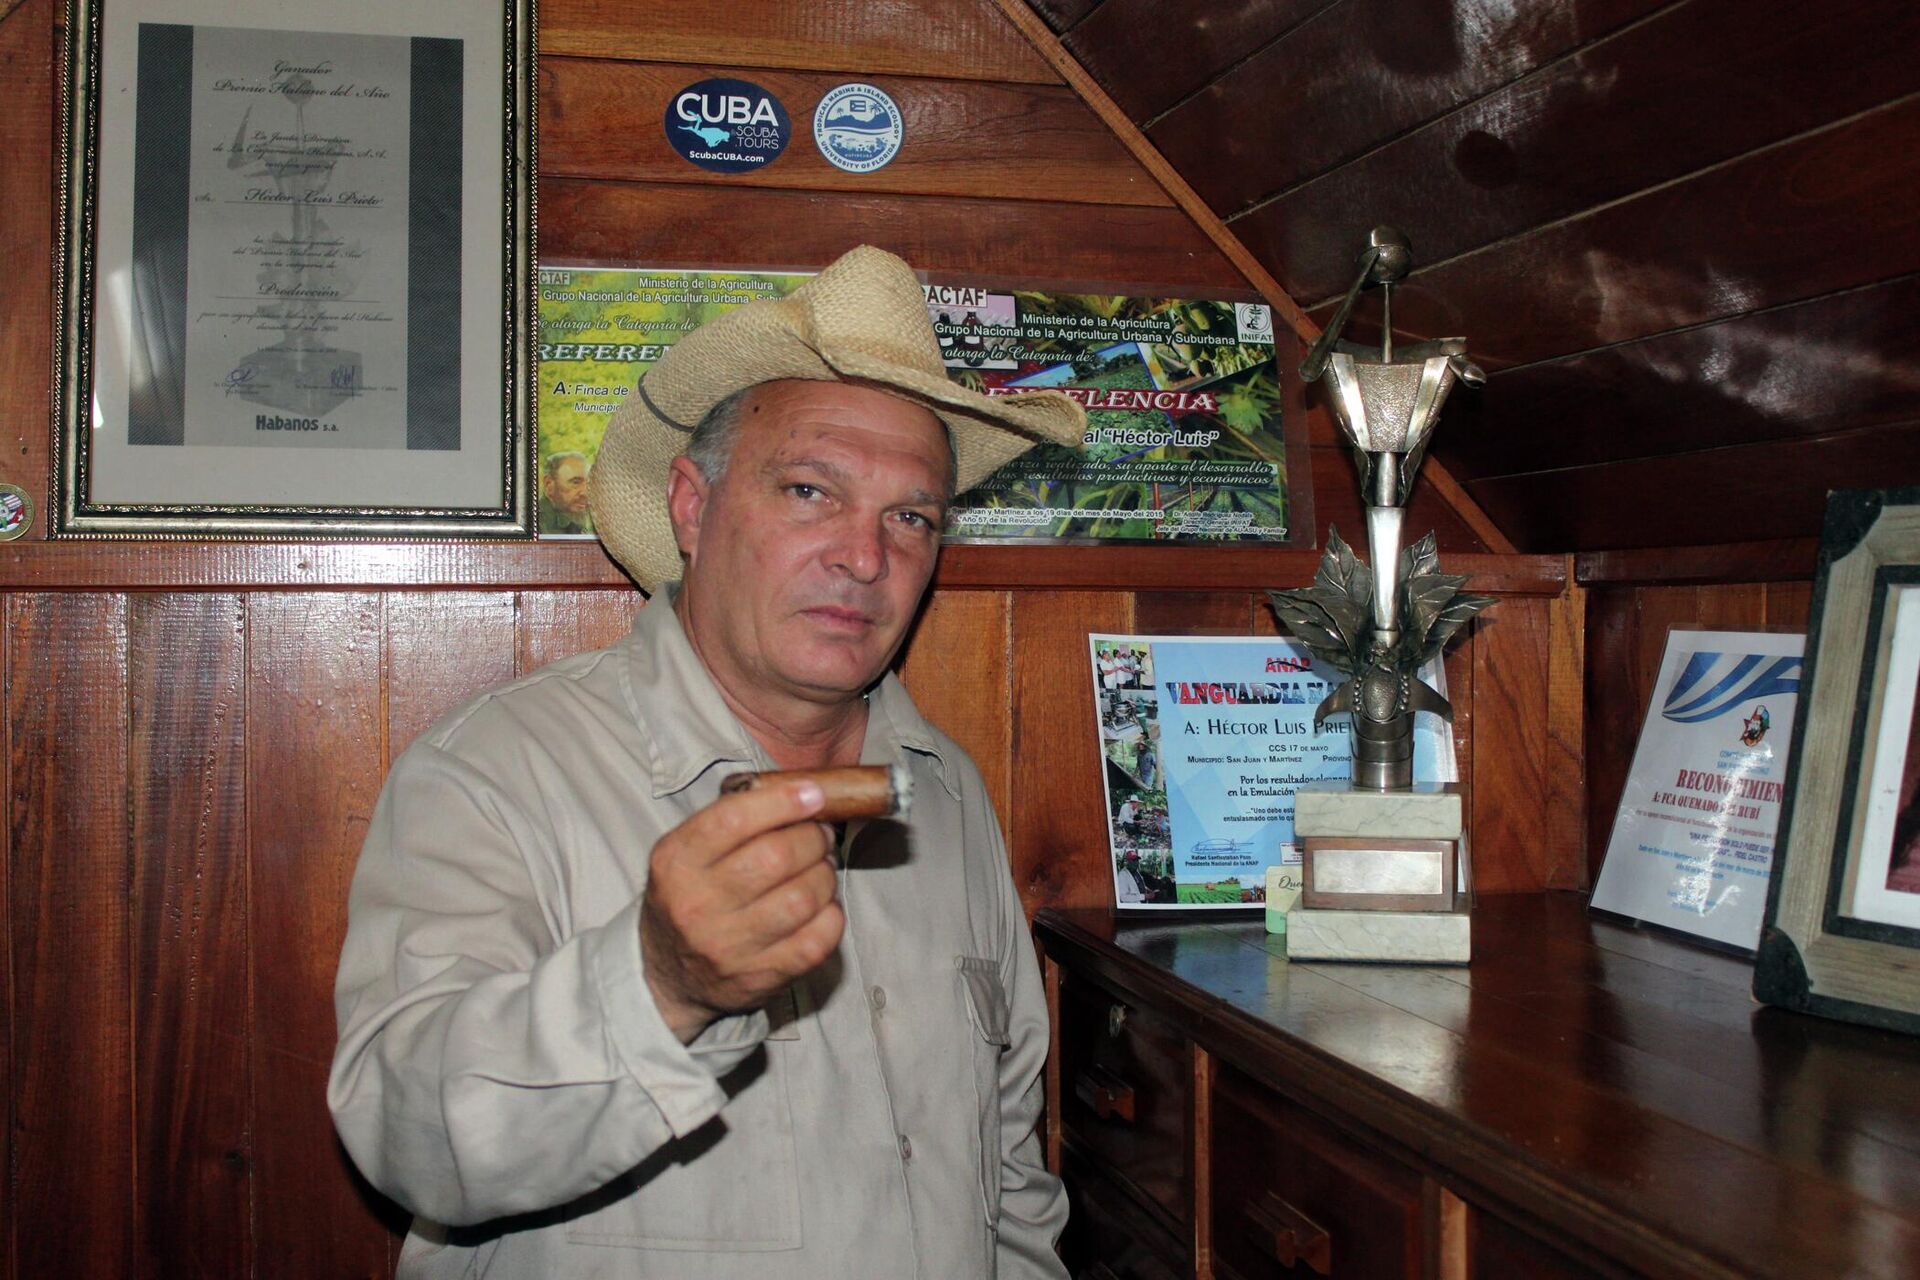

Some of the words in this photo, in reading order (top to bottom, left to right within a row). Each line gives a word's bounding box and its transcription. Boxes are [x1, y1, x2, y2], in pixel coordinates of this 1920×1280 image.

[270, 59, 334, 81] Ganador
[213, 79, 267, 94] Premio
[269, 79, 328, 98] Habano
[329, 84, 355, 98] del
[676, 92, 779, 127] CUBA
[816, 102, 831, 139] TROPICAL
[827, 86, 855, 103] MARINE
[864, 87, 889, 107] ISLAND
[886, 104, 900, 141] ECOLOGY
[735, 125, 779, 139] SCUBA
[736, 137, 779, 150] TOURS
[689, 150, 765, 163] ScubaCUBA.com
[821, 140, 860, 170] UNIVERSITY
[860, 162, 872, 170] OF
[871, 143, 897, 167] FLORIDA
[639, 277, 690, 289] Ministerio
[692, 279, 704, 289] de
[707, 279, 717, 290] la
[719, 279, 774, 293] Agricultura
[543, 290, 576, 304] Grupo
[578, 291, 624, 302] Nacional
[626, 292, 640, 303] de
[642, 292, 652, 303] la
[654, 292, 709, 305] Agricultura
[711, 293, 750, 304] Urbana
[927, 285, 985, 307] ACTAF
[551, 316, 593, 337] otorga
[594, 314, 612, 329] la
[1022, 313, 1077, 327] Ministerio
[1080, 316, 1095, 328] de
[1097, 317, 1108, 328] la
[1110, 317, 1171, 332] Agricultura
[934, 322, 970, 336] Grupo
[973, 325, 1024, 338] Nacional
[1027, 327, 1042, 339] de
[1044, 328, 1056, 339] la
[1058, 328, 1119, 342] Agricultura
[1121, 331, 1164, 344] Urbana
[1165, 334, 1174, 347] y
[1174, 334, 1237, 347] Suburbana
[1240, 332, 1273, 343] INIFAT
[944, 347, 988, 364] otorga
[989, 344, 1005, 360] la
[1008, 345, 1075, 366] Categoría
[553, 381, 572, 396] A:
[575, 383, 609, 396] Finca
[613, 384, 630, 396] de
[256, 415, 320, 433] Habanos
[322, 421, 340, 433] s.a.
[1115, 463, 1132, 471] su
[1135, 461, 1179, 474] aporte
[1180, 459, 1198, 472] al
[1199, 459, 1270, 475] desarrollo
[1095, 471, 1178, 486] productivos
[1179, 475, 1190, 487] y
[1192, 474, 1272, 487] económicos
[969, 507, 986, 516] Juan
[987, 508, 994, 517] y
[994, 508, 1026, 517] Martínez
[1033, 508, 1044, 517] los
[1056, 508, 1073, 517] días
[1073, 508, 1085, 518] del
[1085, 510, 1101, 518] mes
[1102, 509, 1112, 518] de
[1113, 509, 1132, 519] Mayo
[1133, 509, 1145, 518] del
[1146, 510, 1163, 518] 2015
[978, 515, 988, 523] 57
[989, 515, 998, 524] de
[999, 516, 1007, 524] la
[1165, 682, 1306, 705] VANGUARDIA
[1184, 720, 1200, 736] A:
[1208, 717, 1268, 736] HÉCTOR
[1274, 717, 1307, 736] LUIS
[1268, 743, 1287, 753] CCS
[1289, 743, 1299, 753] 17
[1300, 745, 1309, 753] DE
[1310, 745, 1329, 753] MAYO
[1187, 755, 1225, 764] MUNICIPIO:
[1226, 755, 1242, 764] SAN
[1243, 755, 1261, 764] JUAN
[1262, 756, 1268, 764] Y
[1269, 755, 1303, 764] MARTÍNEZ
[1239, 774, 1255, 785] Por
[1256, 773, 1270, 785] los
[1227, 789, 1239, 798] en
[1239, 786, 1249, 797] la
[1249, 786, 1296, 798] Emulación
[1266, 807, 1282, 815] debe
[1223, 815, 1266, 823] entusiasmado
[1266, 816, 1278, 824] con
[1278, 815, 1286, 823] lo
